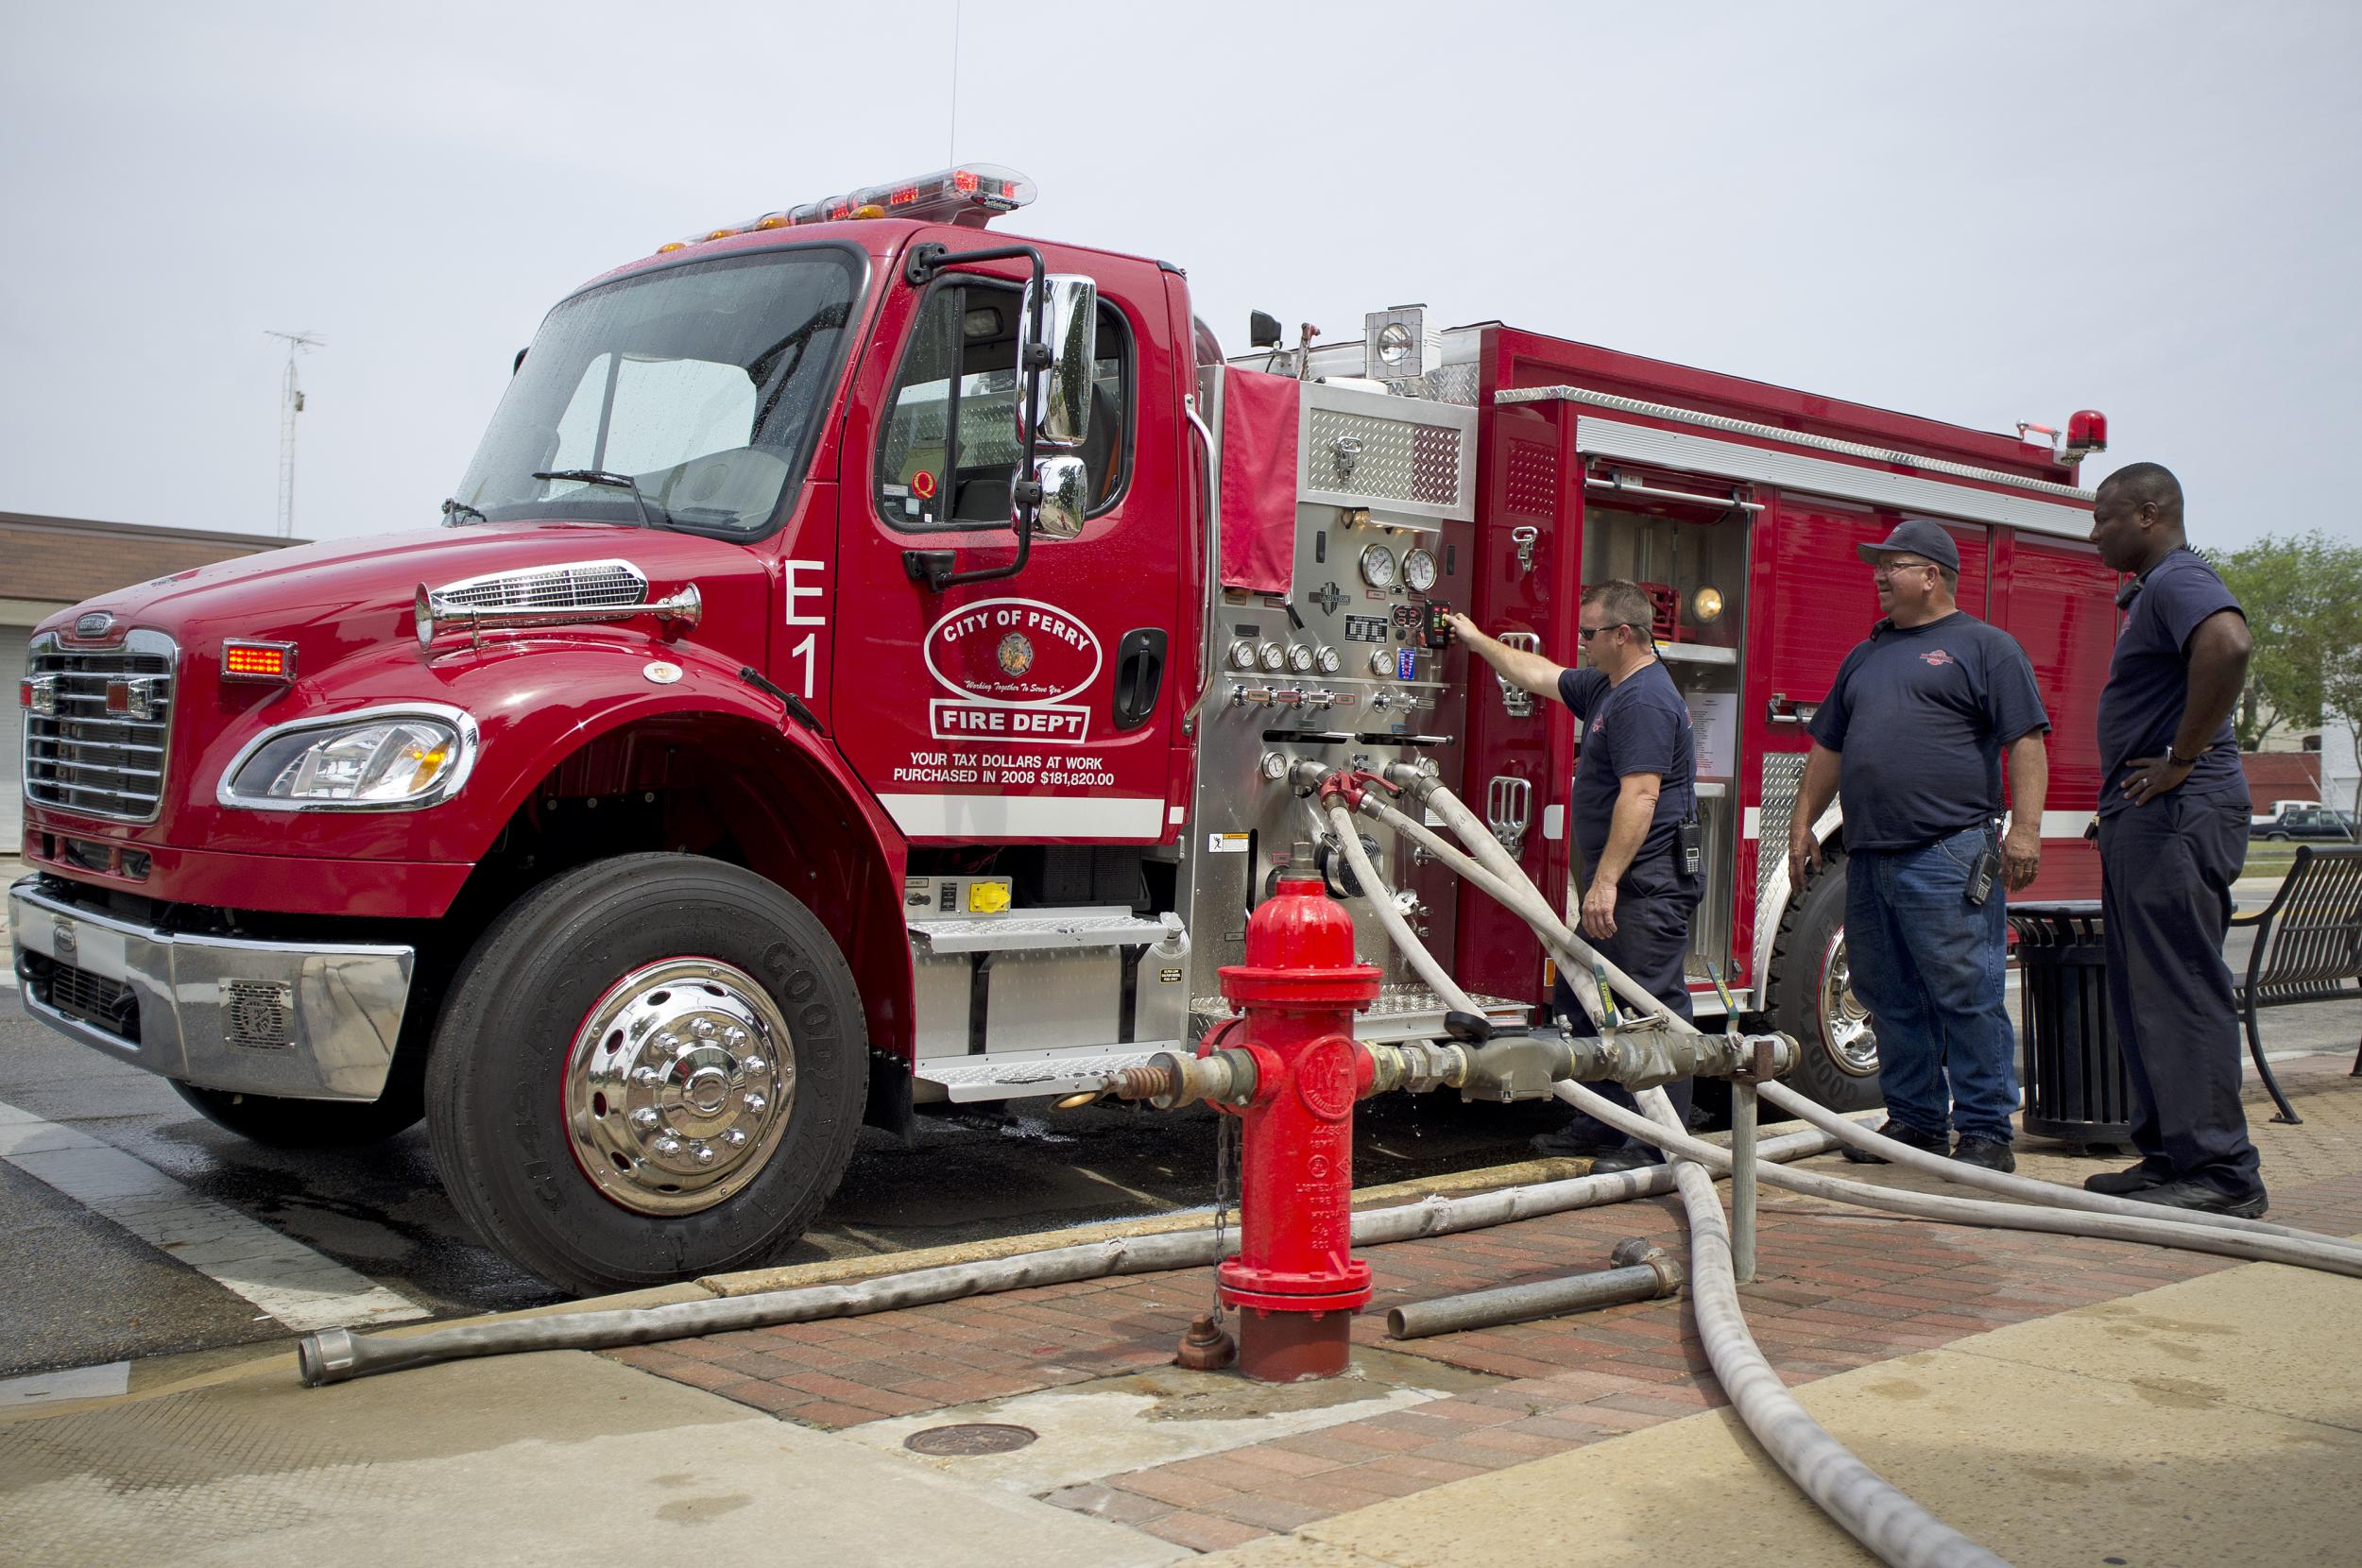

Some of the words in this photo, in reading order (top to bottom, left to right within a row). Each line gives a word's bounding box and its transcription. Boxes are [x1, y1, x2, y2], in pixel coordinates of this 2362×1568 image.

[914, 471, 933, 499] Q
[784, 559, 826, 625] E
[943, 612, 989, 642] CITY
[997, 609, 1022, 625] OF
[1028, 612, 1090, 652] PERRY
[792, 633, 815, 699] 1
[993, 681, 1019, 693] Together
[1020, 683, 1029, 692] To
[1029, 683, 1048, 693] Serve
[942, 710, 1005, 731] FIRE
[1013, 713, 1083, 733] DEPT
[910, 752, 948, 766] YOUR
[952, 753, 977, 766] TAX
[982, 754, 1042, 768] DOLLARS
[1046, 756, 1061, 769] AT
[1066, 757, 1104, 770] WORK
[893, 768, 978, 783] PURCHASED
[983, 770, 996, 783] IN
[1001, 771, 1036, 784] 2008
[1040, 771, 1115, 787] $181,820.00
